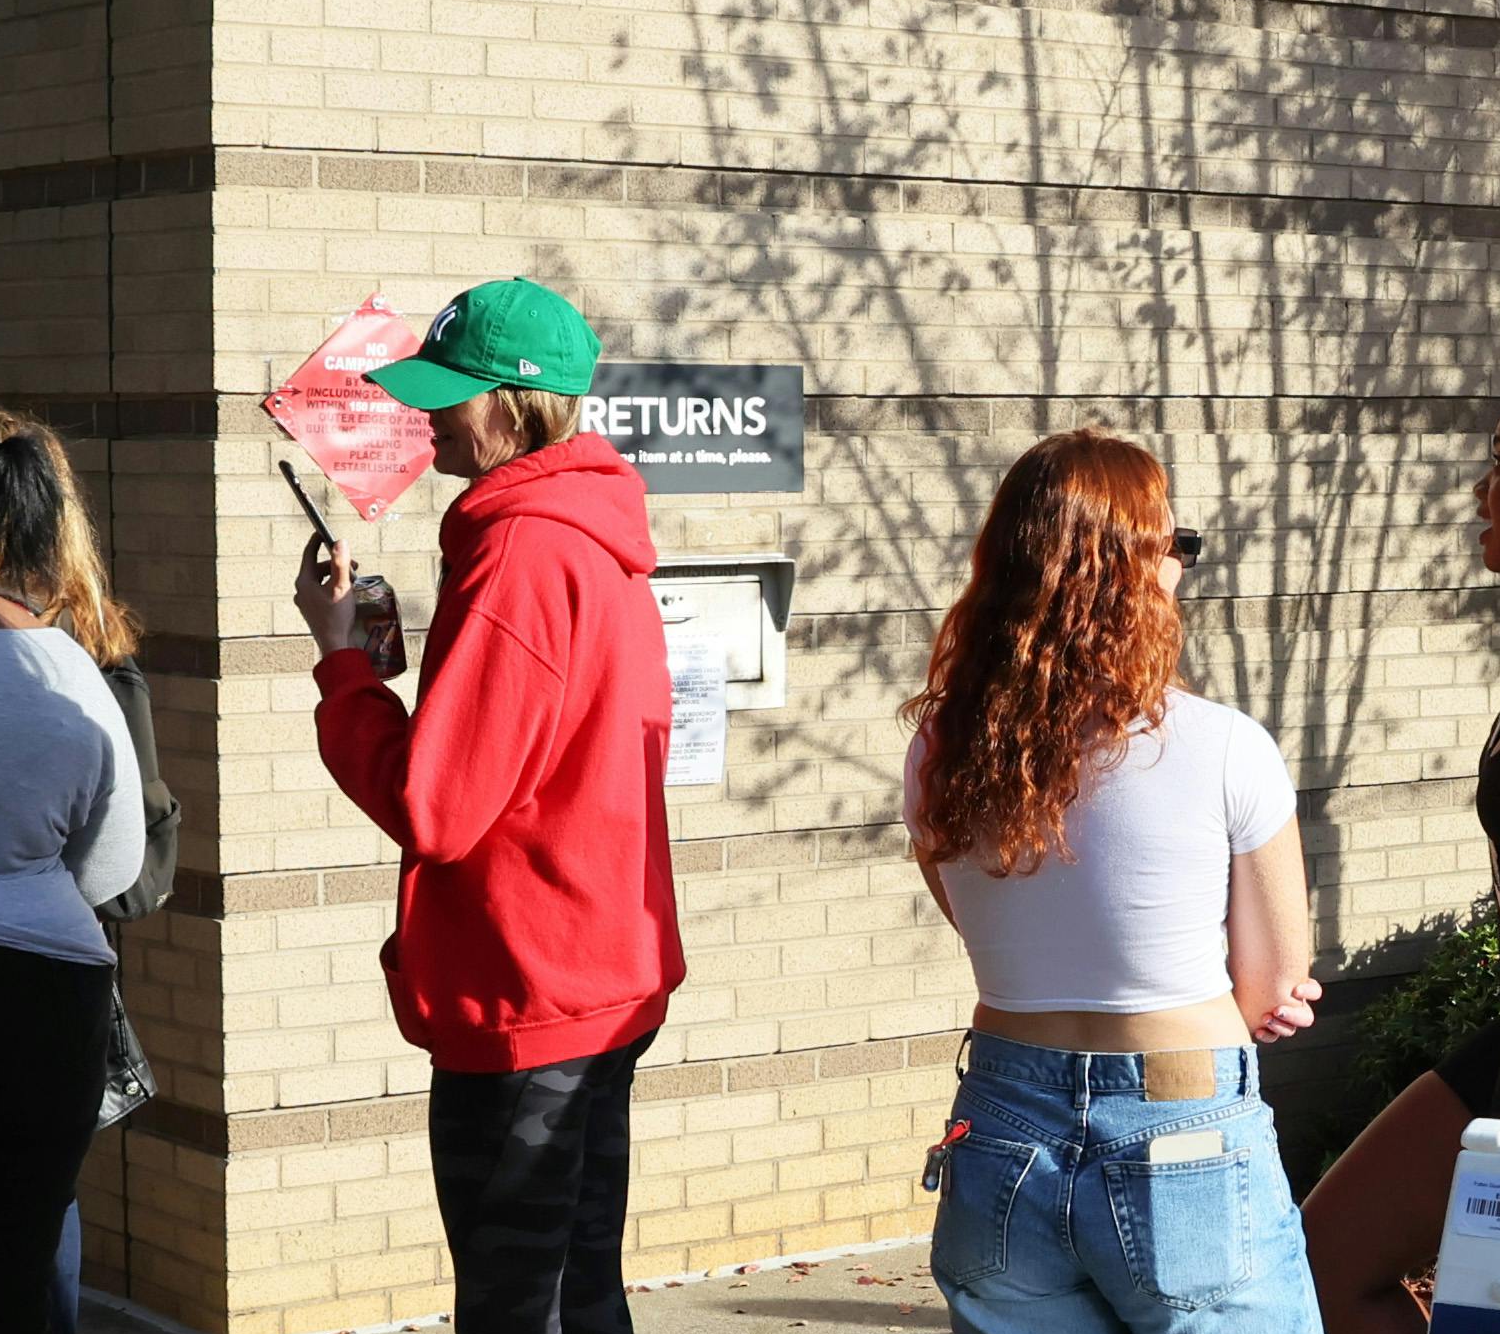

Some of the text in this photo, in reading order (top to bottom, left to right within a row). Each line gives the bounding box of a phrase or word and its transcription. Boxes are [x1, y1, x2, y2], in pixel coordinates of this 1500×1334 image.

[365, 342, 388, 357] NO
[345, 377, 360, 387] BY
[306, 387, 370, 400] (INCLUDING
[306, 399, 346, 411] WITHIN
[369, 402, 398, 414] FEET
[319, 412, 430, 427] OUTER EDGE OF ANY
[580, 395, 767, 436] RETURNS
[404, 427, 436, 439] WHIC
[357, 438, 402, 450] OLLING
[349, 450, 397, 461] PLACE IS
[638, 450, 667, 464] item
[668, 451, 683, 464] at
[684, 453, 693, 464] a
[695, 450, 727, 465] time,
[728, 448, 772, 466] please.
